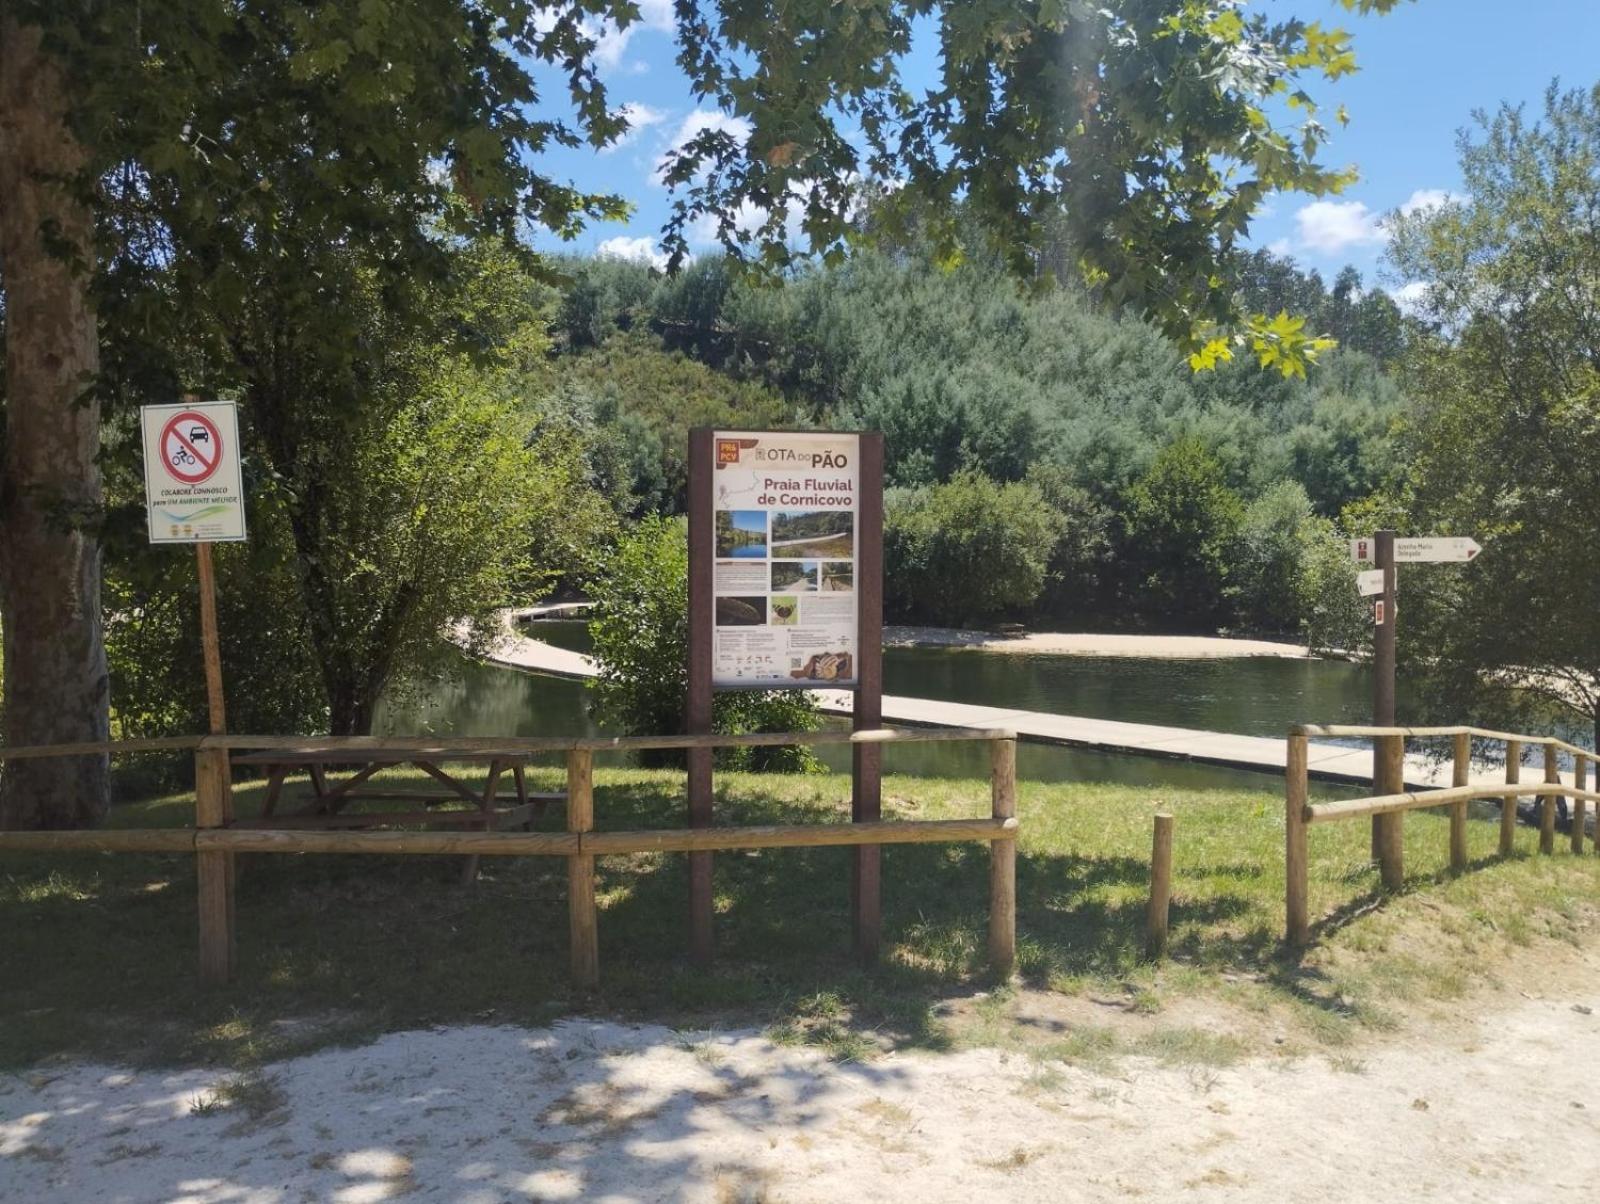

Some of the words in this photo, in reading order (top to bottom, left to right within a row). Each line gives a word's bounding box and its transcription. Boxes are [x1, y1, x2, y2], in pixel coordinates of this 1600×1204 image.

[720, 452, 737, 462] PCV
[812, 450, 848, 468] PÃO
[764, 478, 801, 491] Praia
[805, 479, 852, 491] Fluvial
[161, 488, 191, 496] COLABORE
[193, 487, 228, 495] CONNOSCO
[179, 497, 210, 505] AMBIENTE
[211, 496, 238, 504] MELHOR
[757, 494, 776, 505] de
[780, 494, 852, 506] Cornicovo
